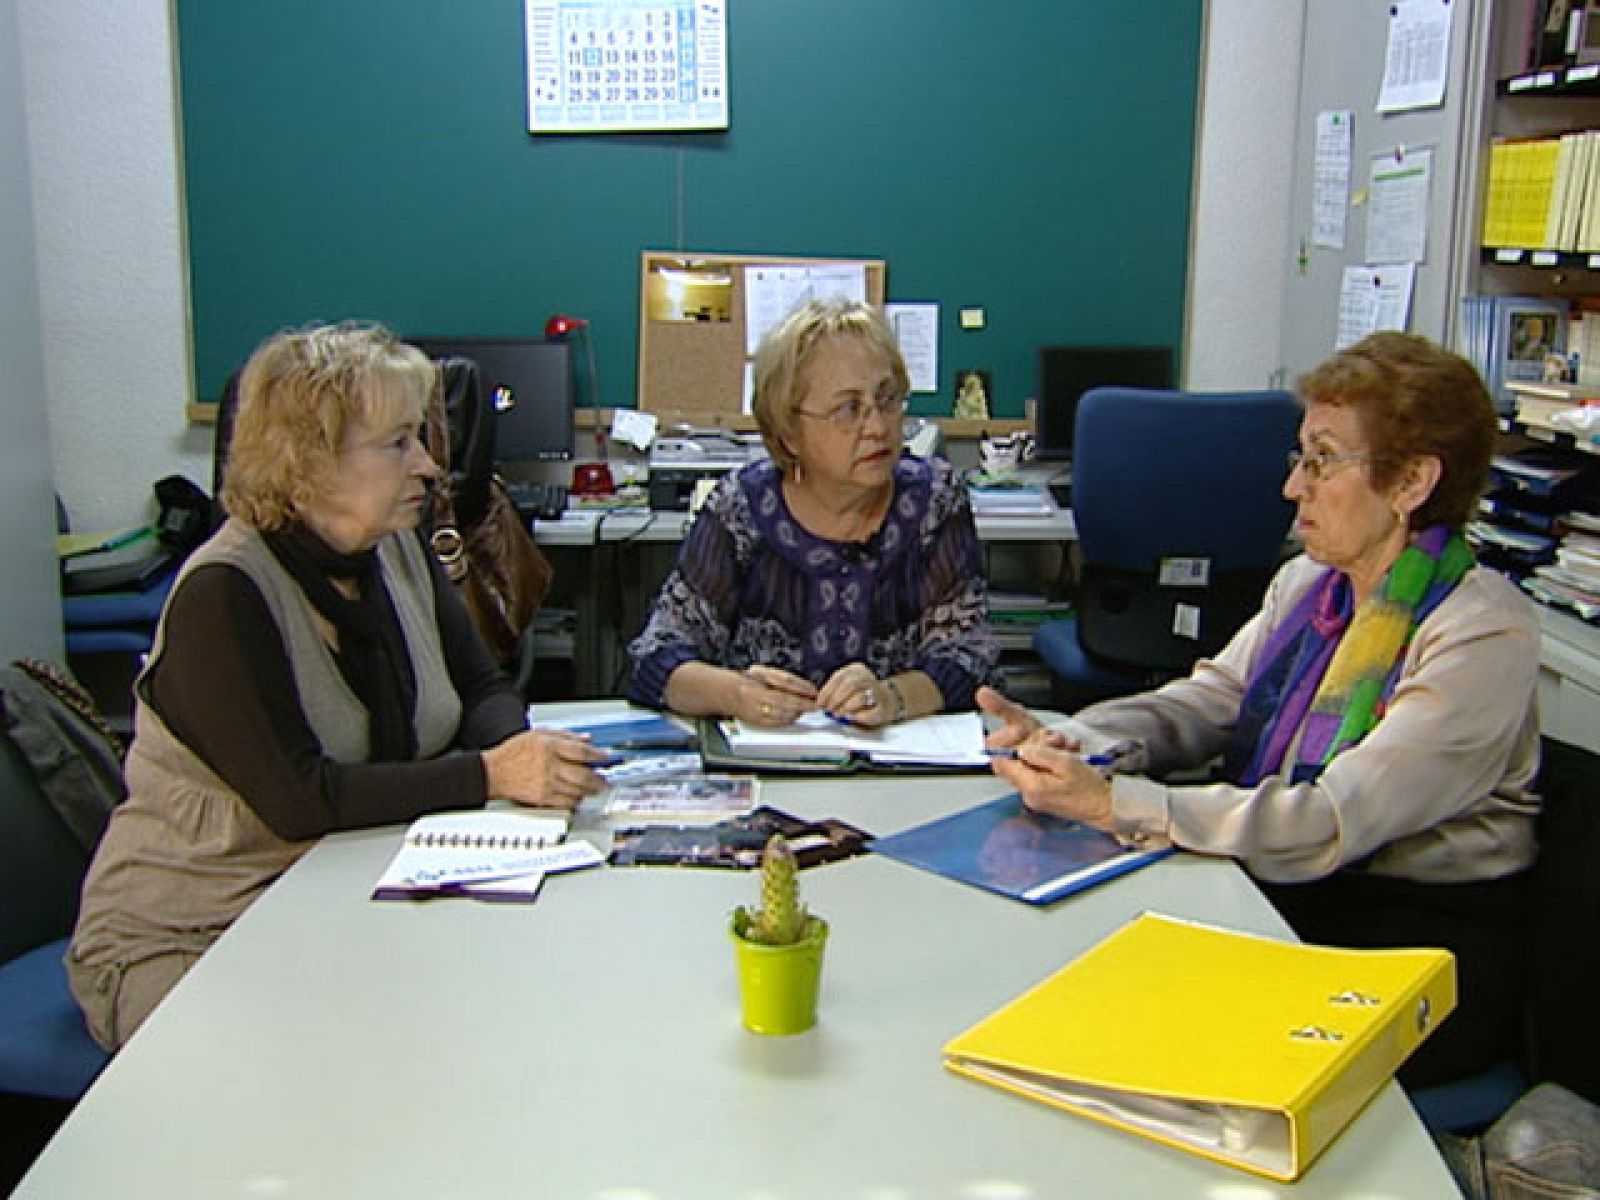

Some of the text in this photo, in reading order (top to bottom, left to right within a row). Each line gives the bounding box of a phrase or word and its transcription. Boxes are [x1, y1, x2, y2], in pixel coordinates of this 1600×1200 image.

[626, 30, 635, 44] 7
[569, 50, 581, 65] 11
[606, 50, 619, 63] 13
[624, 50, 638, 63] 14
[644, 49, 657, 63] 15
[569, 70, 582, 83] 18
[606, 69, 620, 83] 20
[624, 68, 638, 82] 21
[643, 67, 657, 82] 22
[661, 67, 675, 82] 23
[569, 87, 675, 103] 25 26 27 28 29 30
